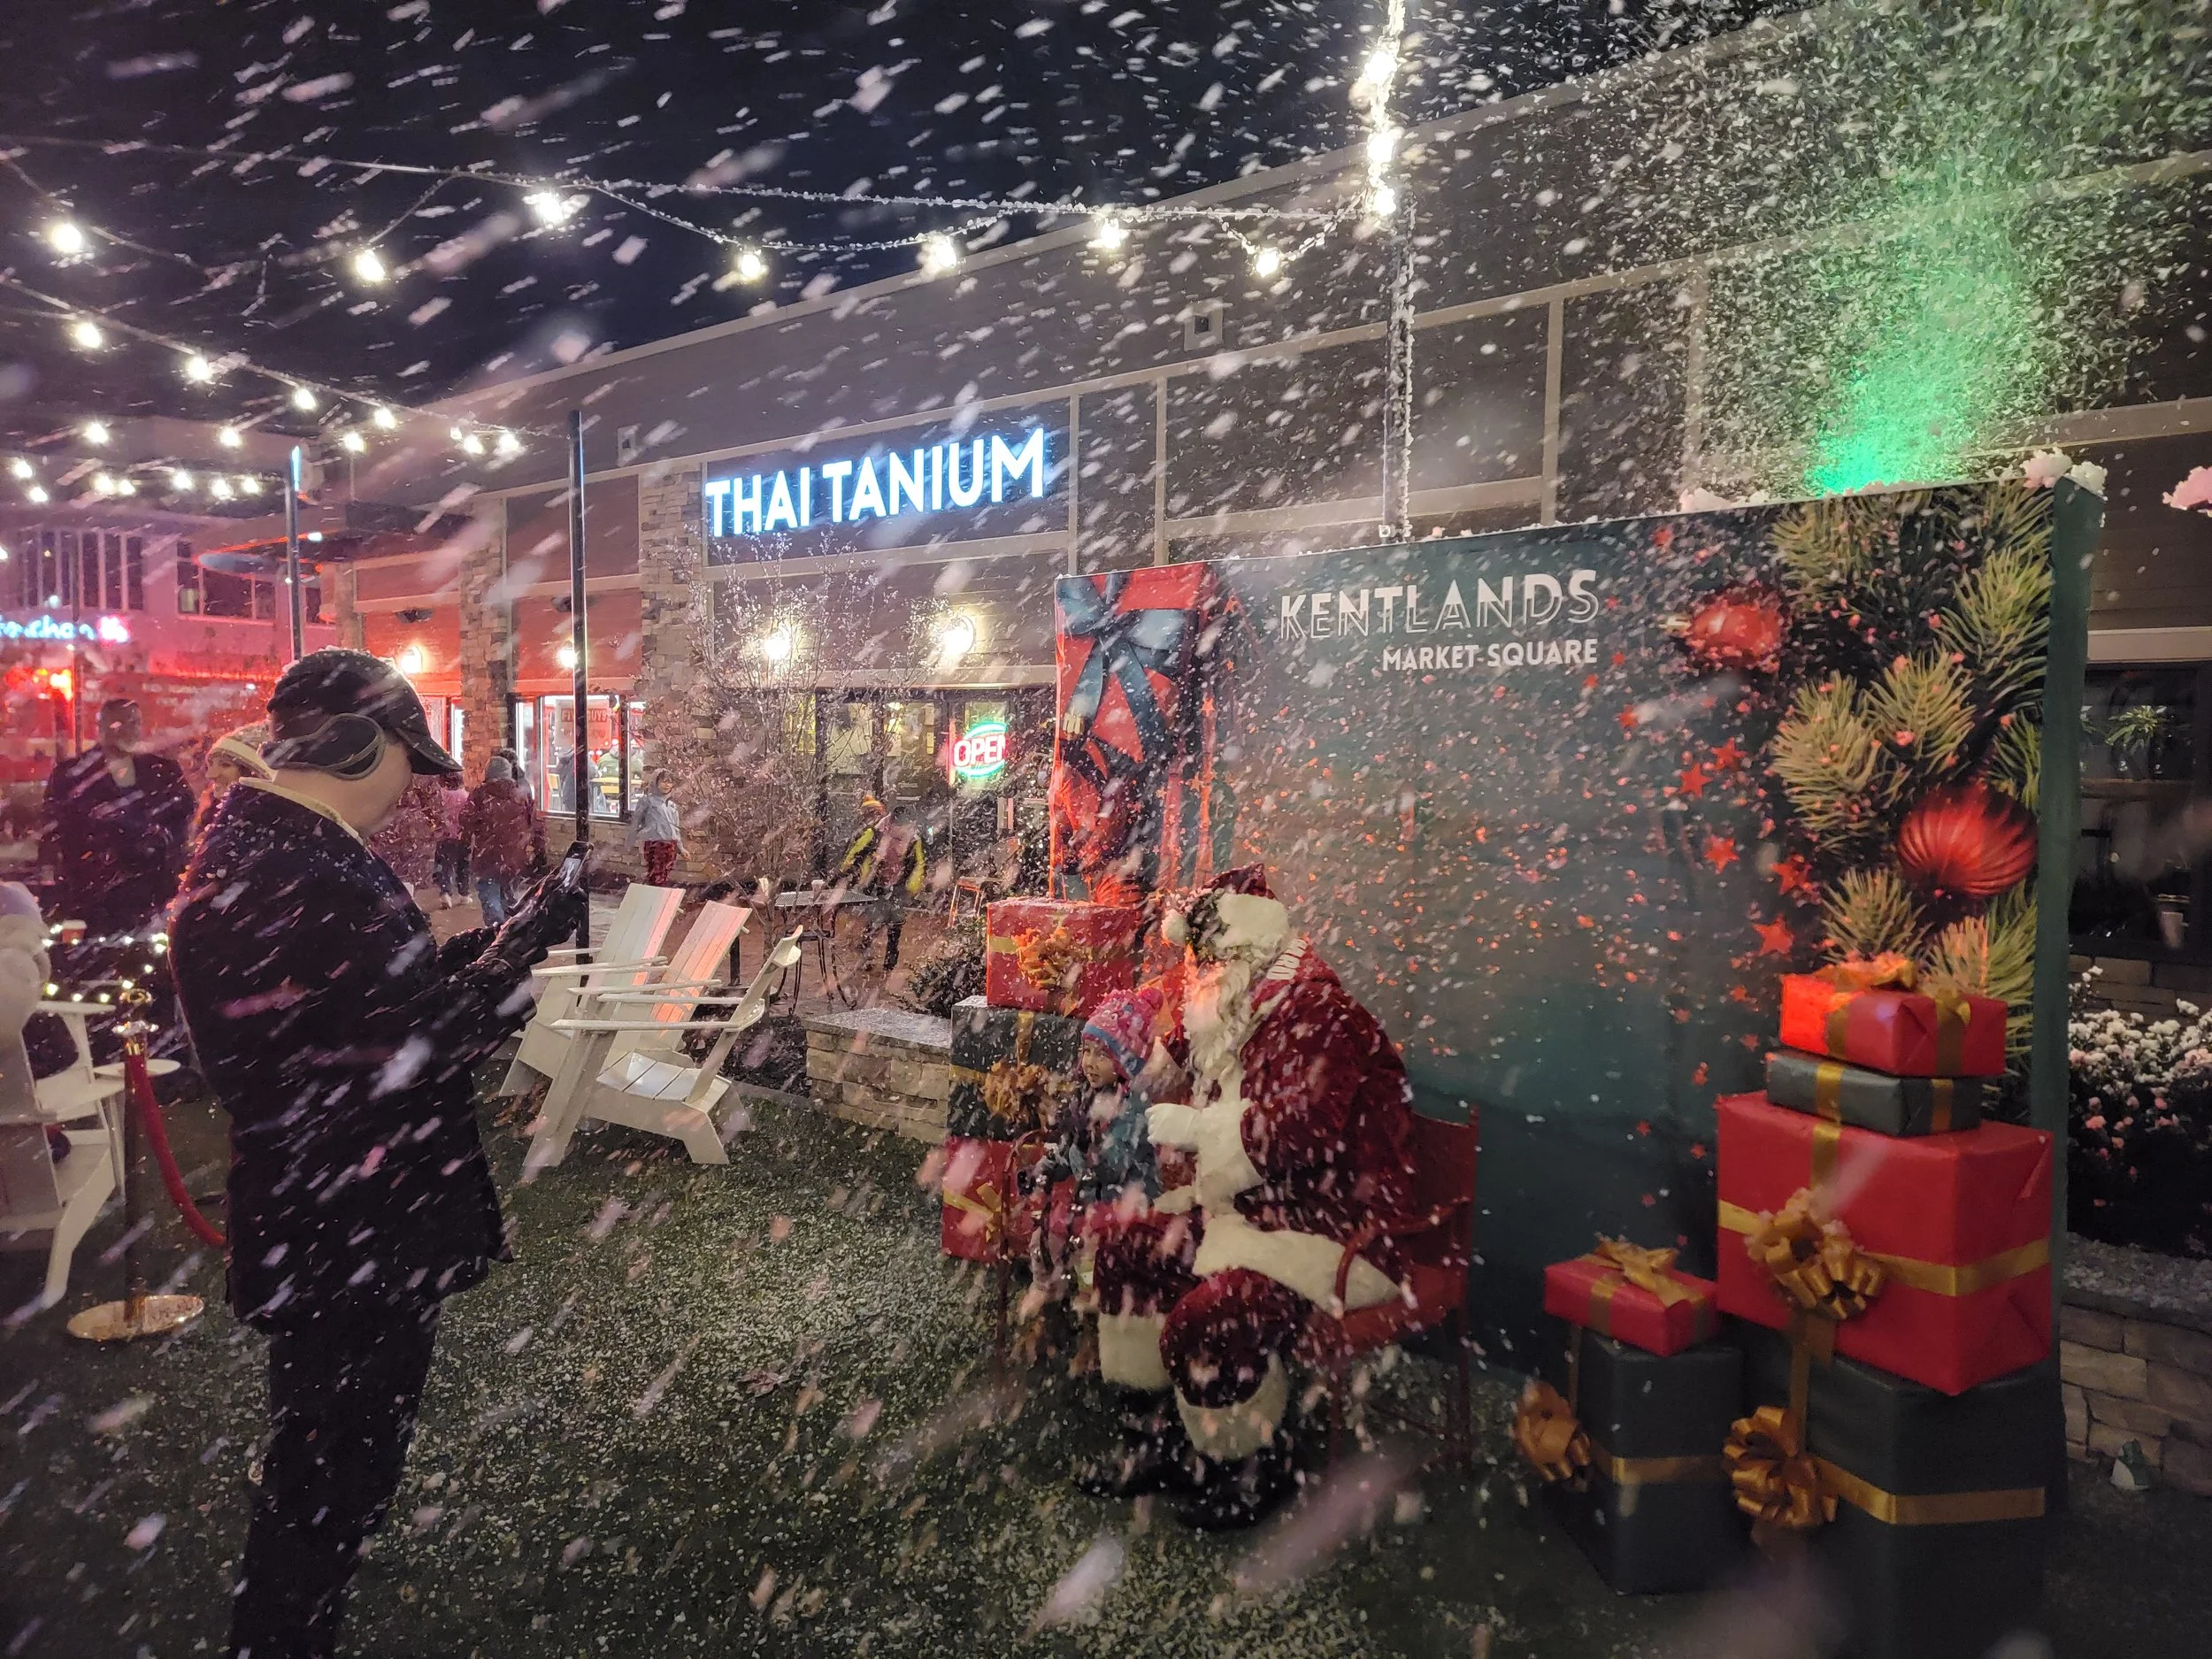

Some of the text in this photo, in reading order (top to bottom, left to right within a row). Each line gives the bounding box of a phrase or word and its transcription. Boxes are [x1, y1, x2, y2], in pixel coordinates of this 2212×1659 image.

[705, 427, 1044, 537] THAI TANIUM
[1280, 569, 1601, 641] KENTLANDS
[1382, 638, 1598, 672] MARKET SQUARE
